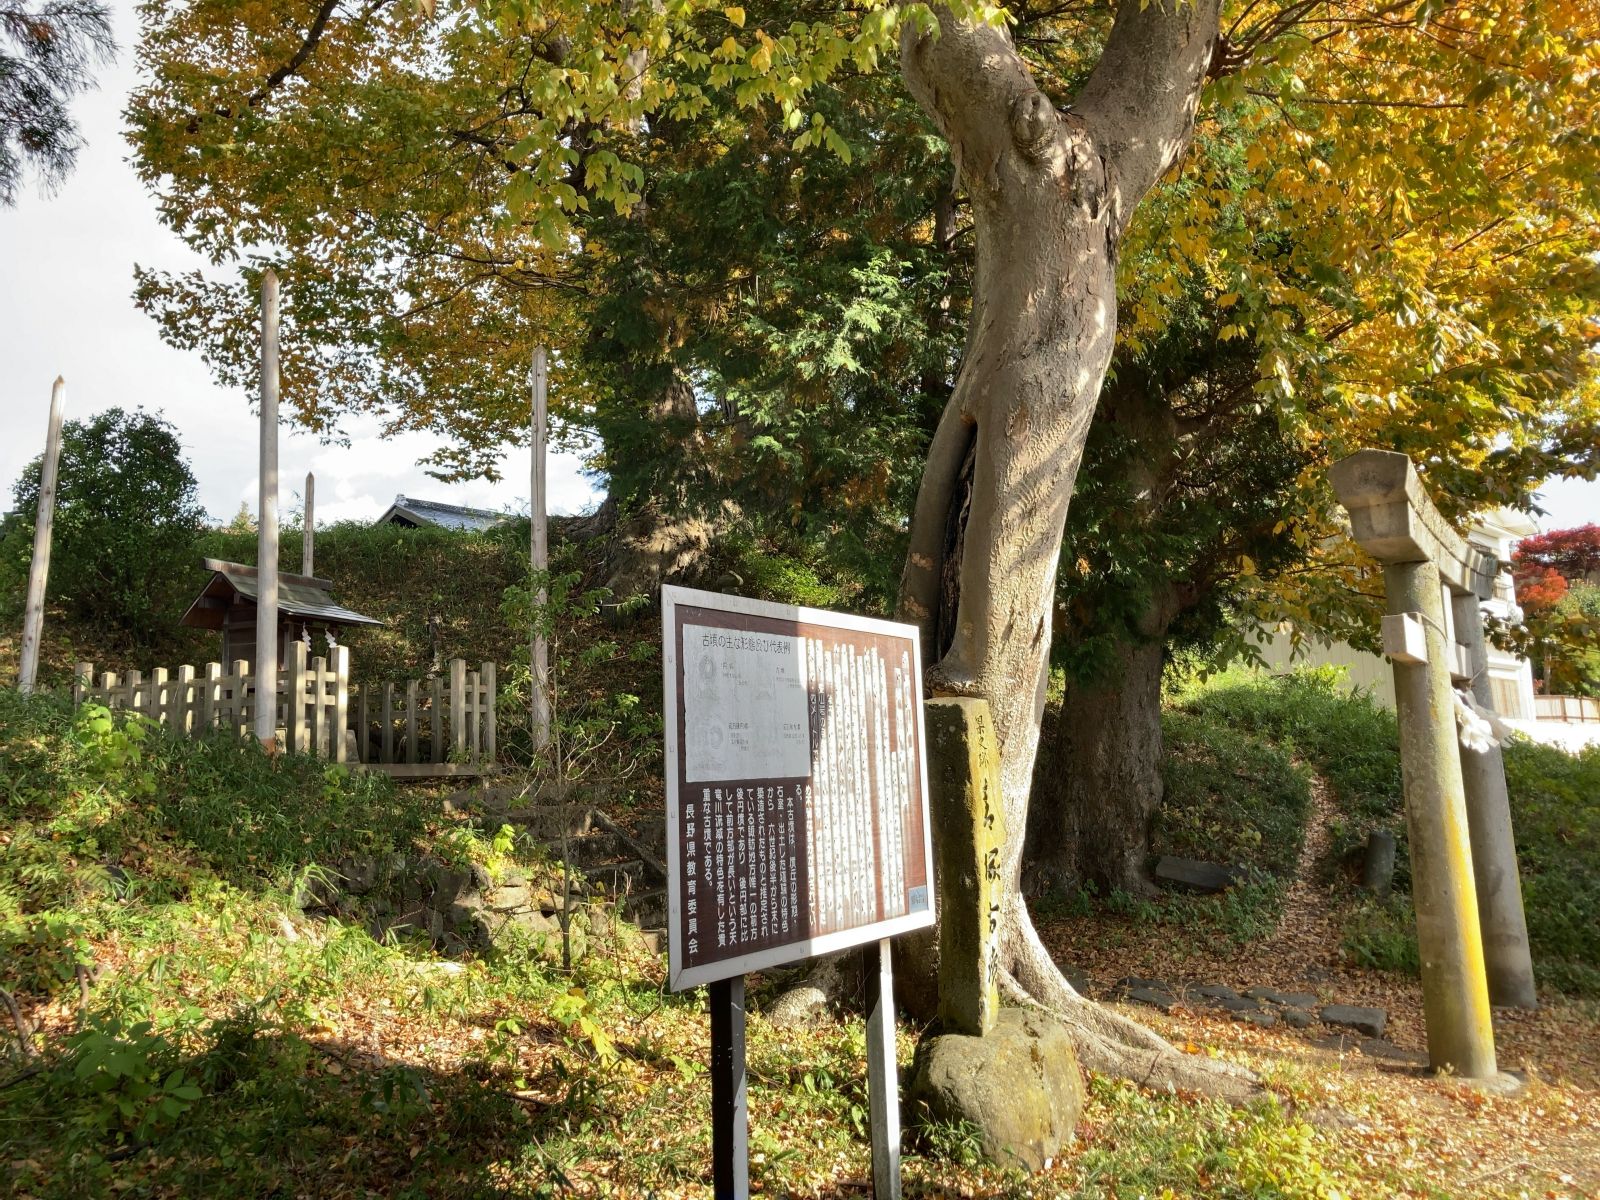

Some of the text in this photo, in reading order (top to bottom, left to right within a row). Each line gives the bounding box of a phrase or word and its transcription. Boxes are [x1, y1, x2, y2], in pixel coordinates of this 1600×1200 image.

[701, 633, 791, 654] 古墳の主な形態及び代表例
[686, 803, 698, 954] 長野県教育委員会
[702, 788, 713, 887] 重な古墳である。
[714, 788, 726, 948] 竜川流域の特色を有した貴
[725, 788, 737, 945] して前方部が長いという天
[757, 787, 768, 938] 築造されたものと推定され
